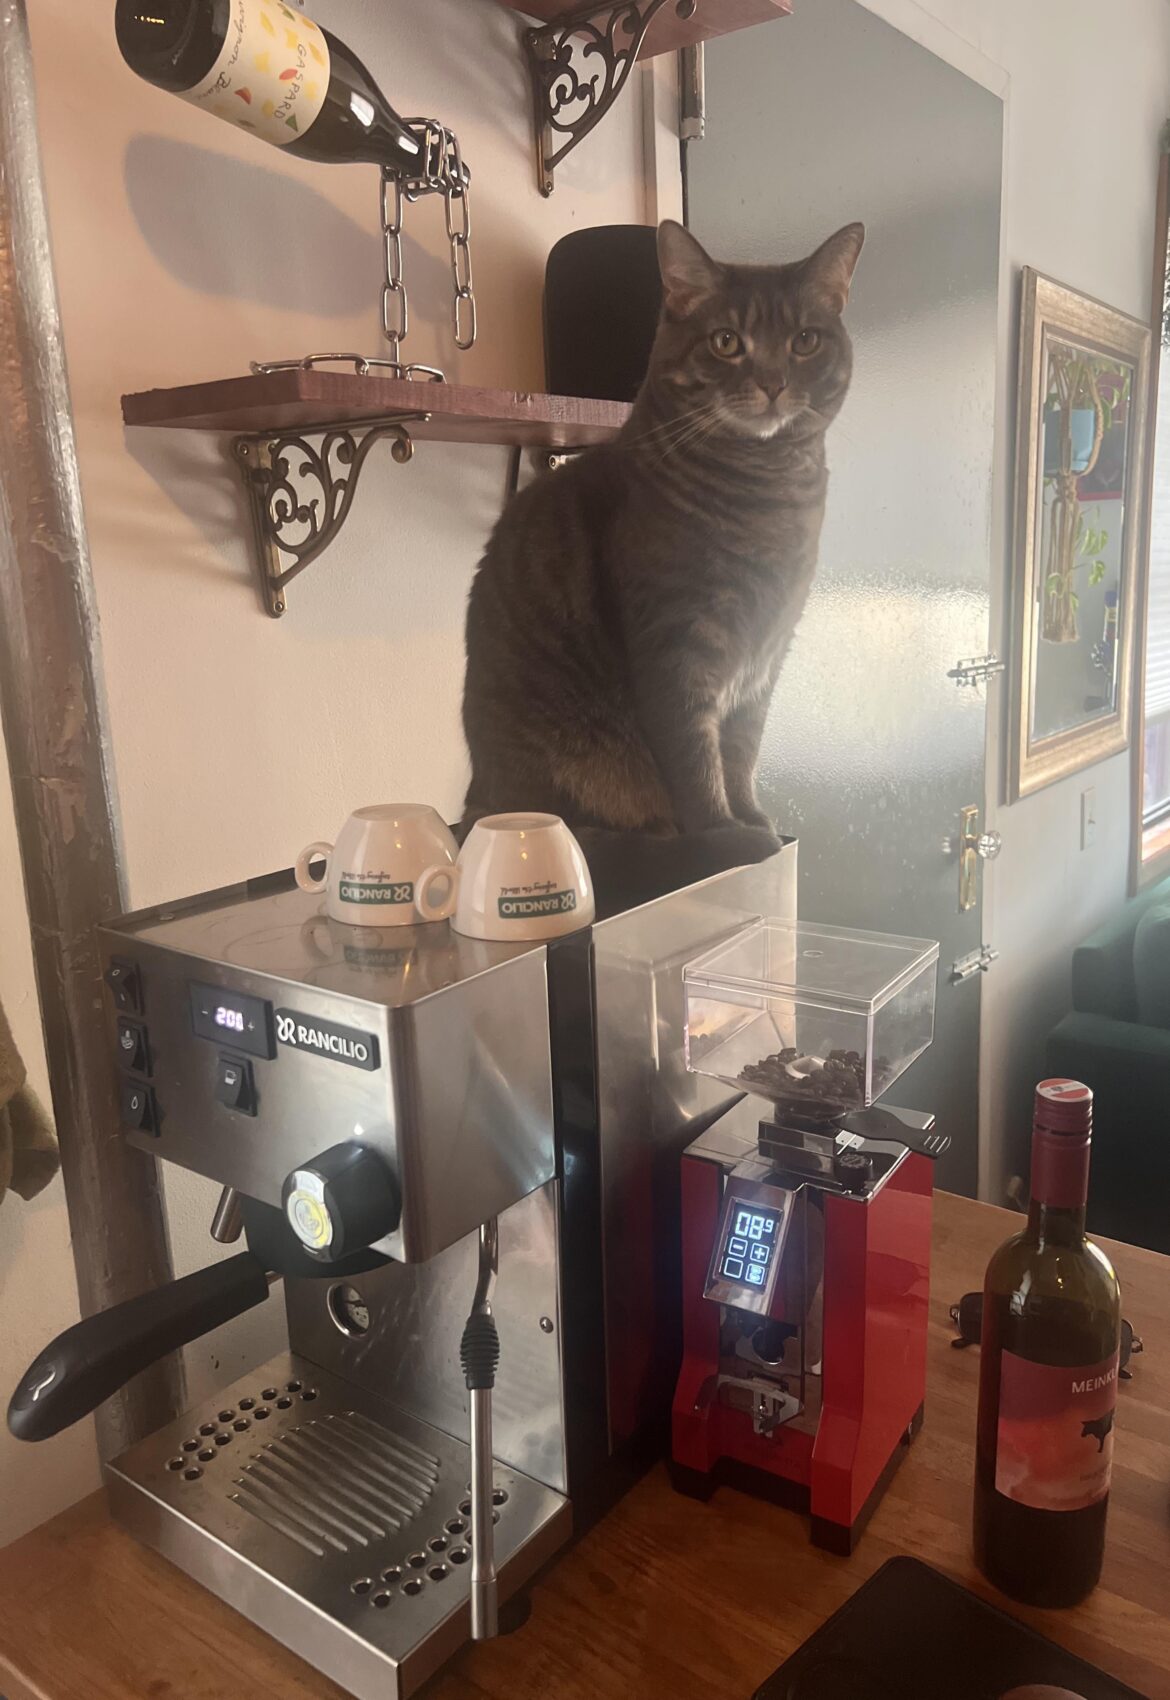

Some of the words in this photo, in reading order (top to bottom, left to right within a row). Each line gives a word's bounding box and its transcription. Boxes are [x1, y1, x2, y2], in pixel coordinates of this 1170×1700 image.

[273, 43, 308, 119] GASPARD
[341, 886, 391, 900] RANCILIO
[502, 898, 559, 914] RANCILIO
[297, 1025, 368, 1061] RANCILIO
